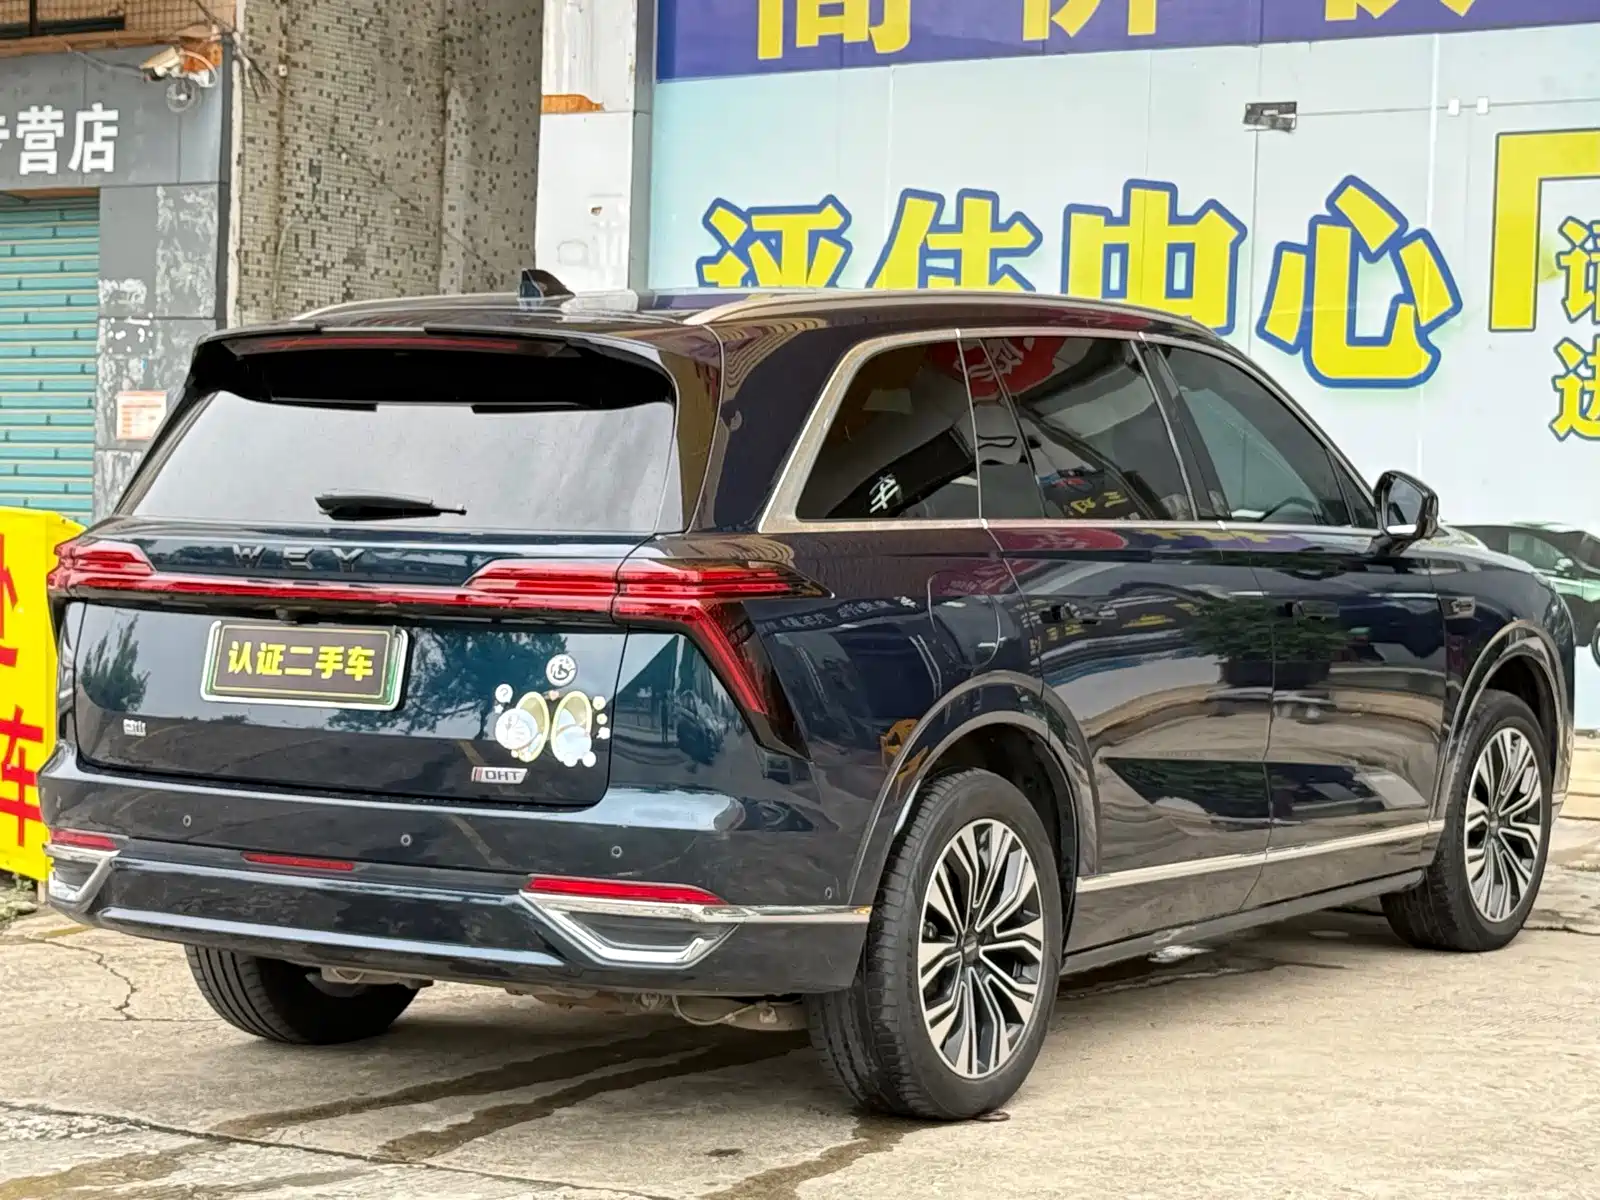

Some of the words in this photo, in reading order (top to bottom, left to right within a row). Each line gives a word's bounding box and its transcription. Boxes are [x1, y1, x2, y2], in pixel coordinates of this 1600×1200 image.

[694, 175, 1462, 388] 评估中心
[232, 543, 366, 573] WEY
[228, 641, 376, 681] 认证二手车
